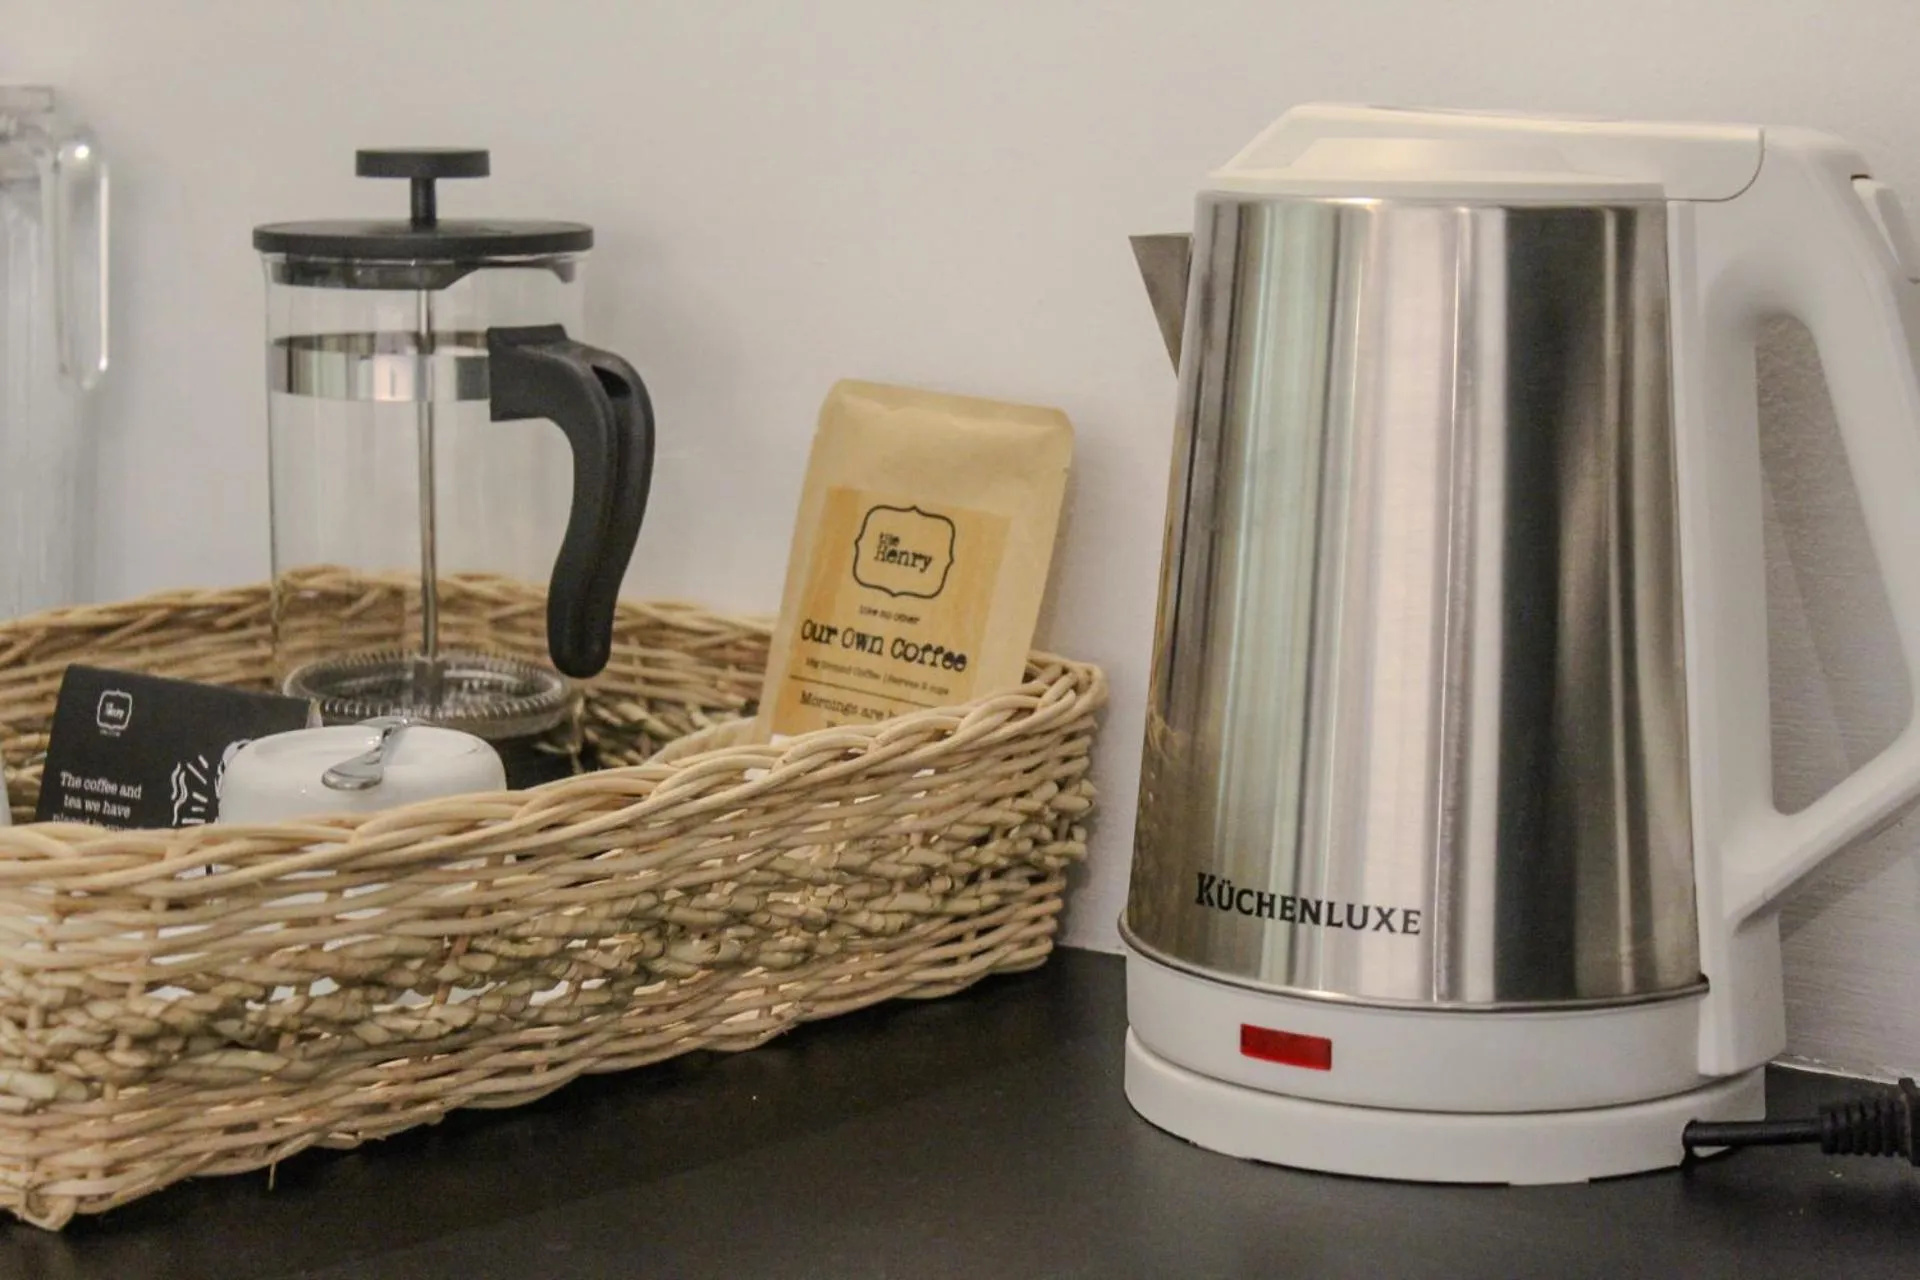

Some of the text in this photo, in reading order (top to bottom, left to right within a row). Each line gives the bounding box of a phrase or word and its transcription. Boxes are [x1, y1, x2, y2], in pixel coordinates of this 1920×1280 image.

[873, 544, 933, 574] Henry
[801, 619, 968, 673] Our Own Coffee
[800, 690, 859, 717] Mornings
[860, 706, 884, 722] are
[60, 770, 142, 800] The coffee and
[63, 794, 82, 810] tea
[84, 799, 101, 814] we
[102, 800, 131, 819] have
[1194, 871, 1422, 936] KÜCHENLUXE
